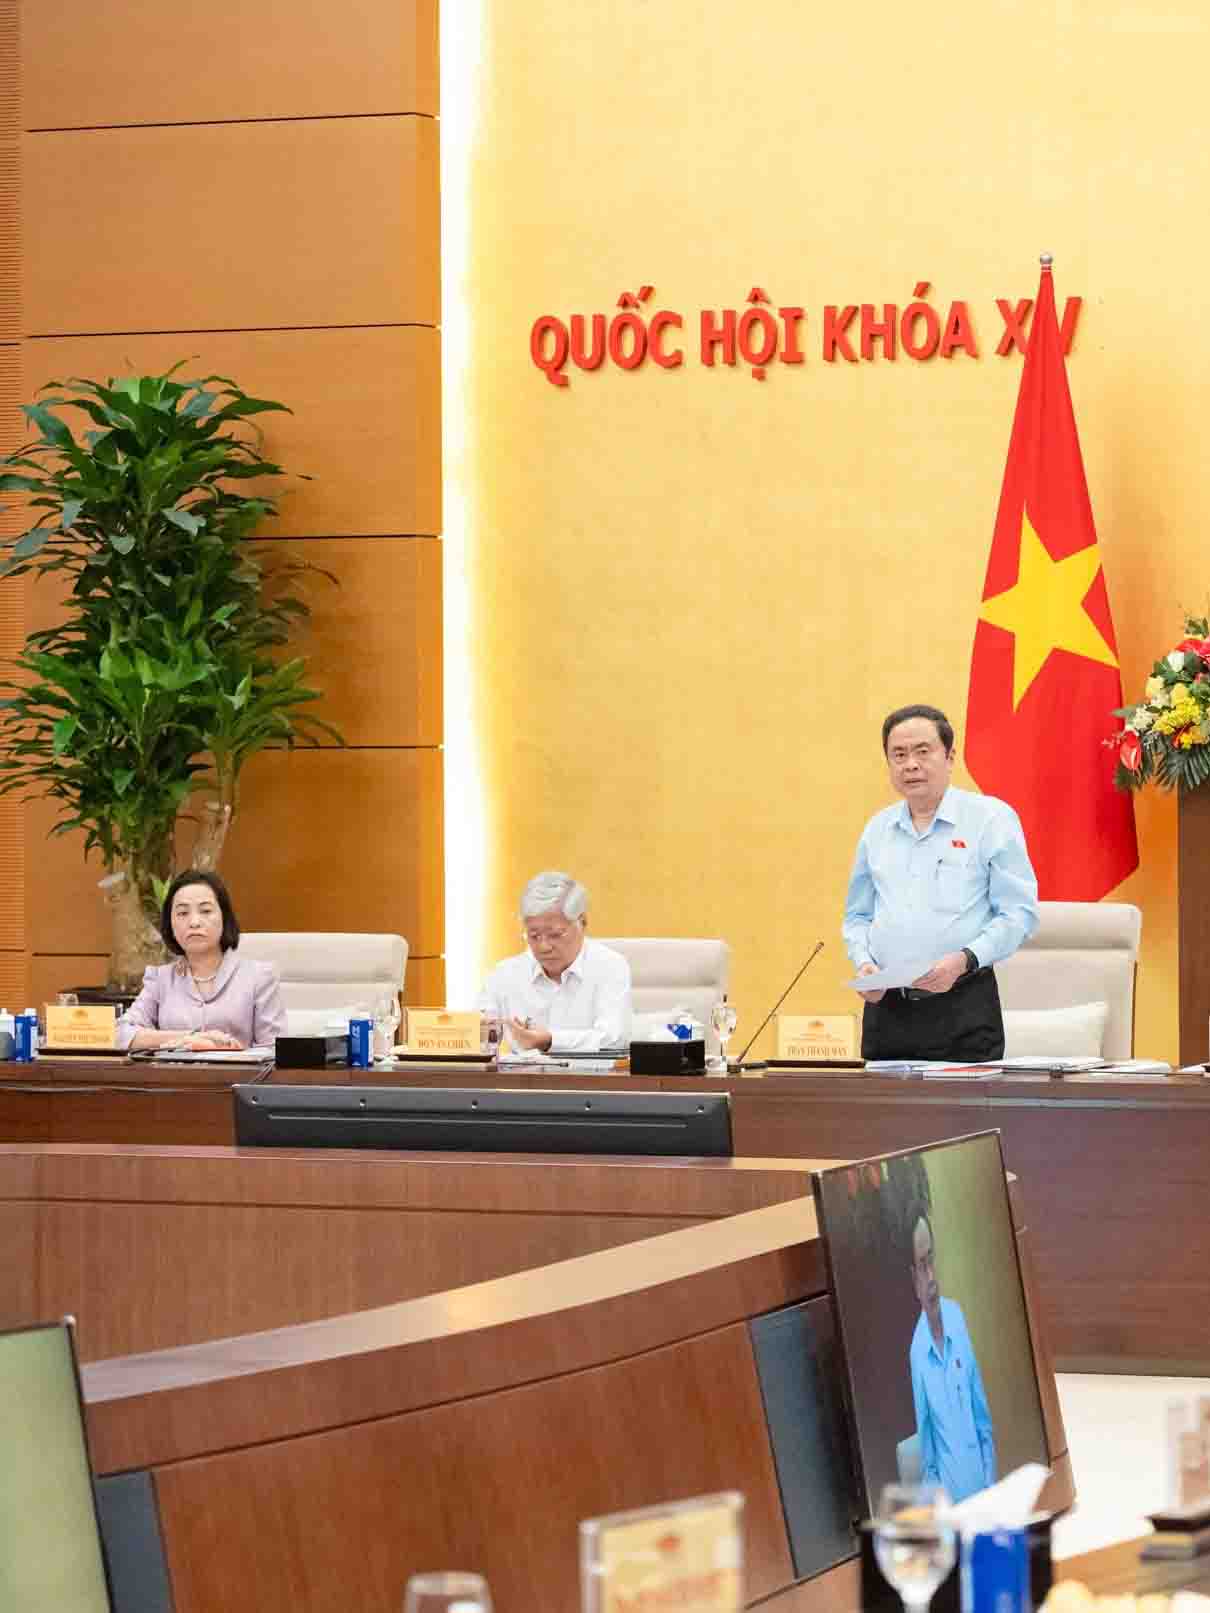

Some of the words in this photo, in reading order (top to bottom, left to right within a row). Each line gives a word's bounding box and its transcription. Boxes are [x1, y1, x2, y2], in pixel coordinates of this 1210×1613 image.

[530, 285, 683, 386] QUỐC
[701, 287, 804, 380] HỘI
[822, 282, 978, 362] KHÓA
